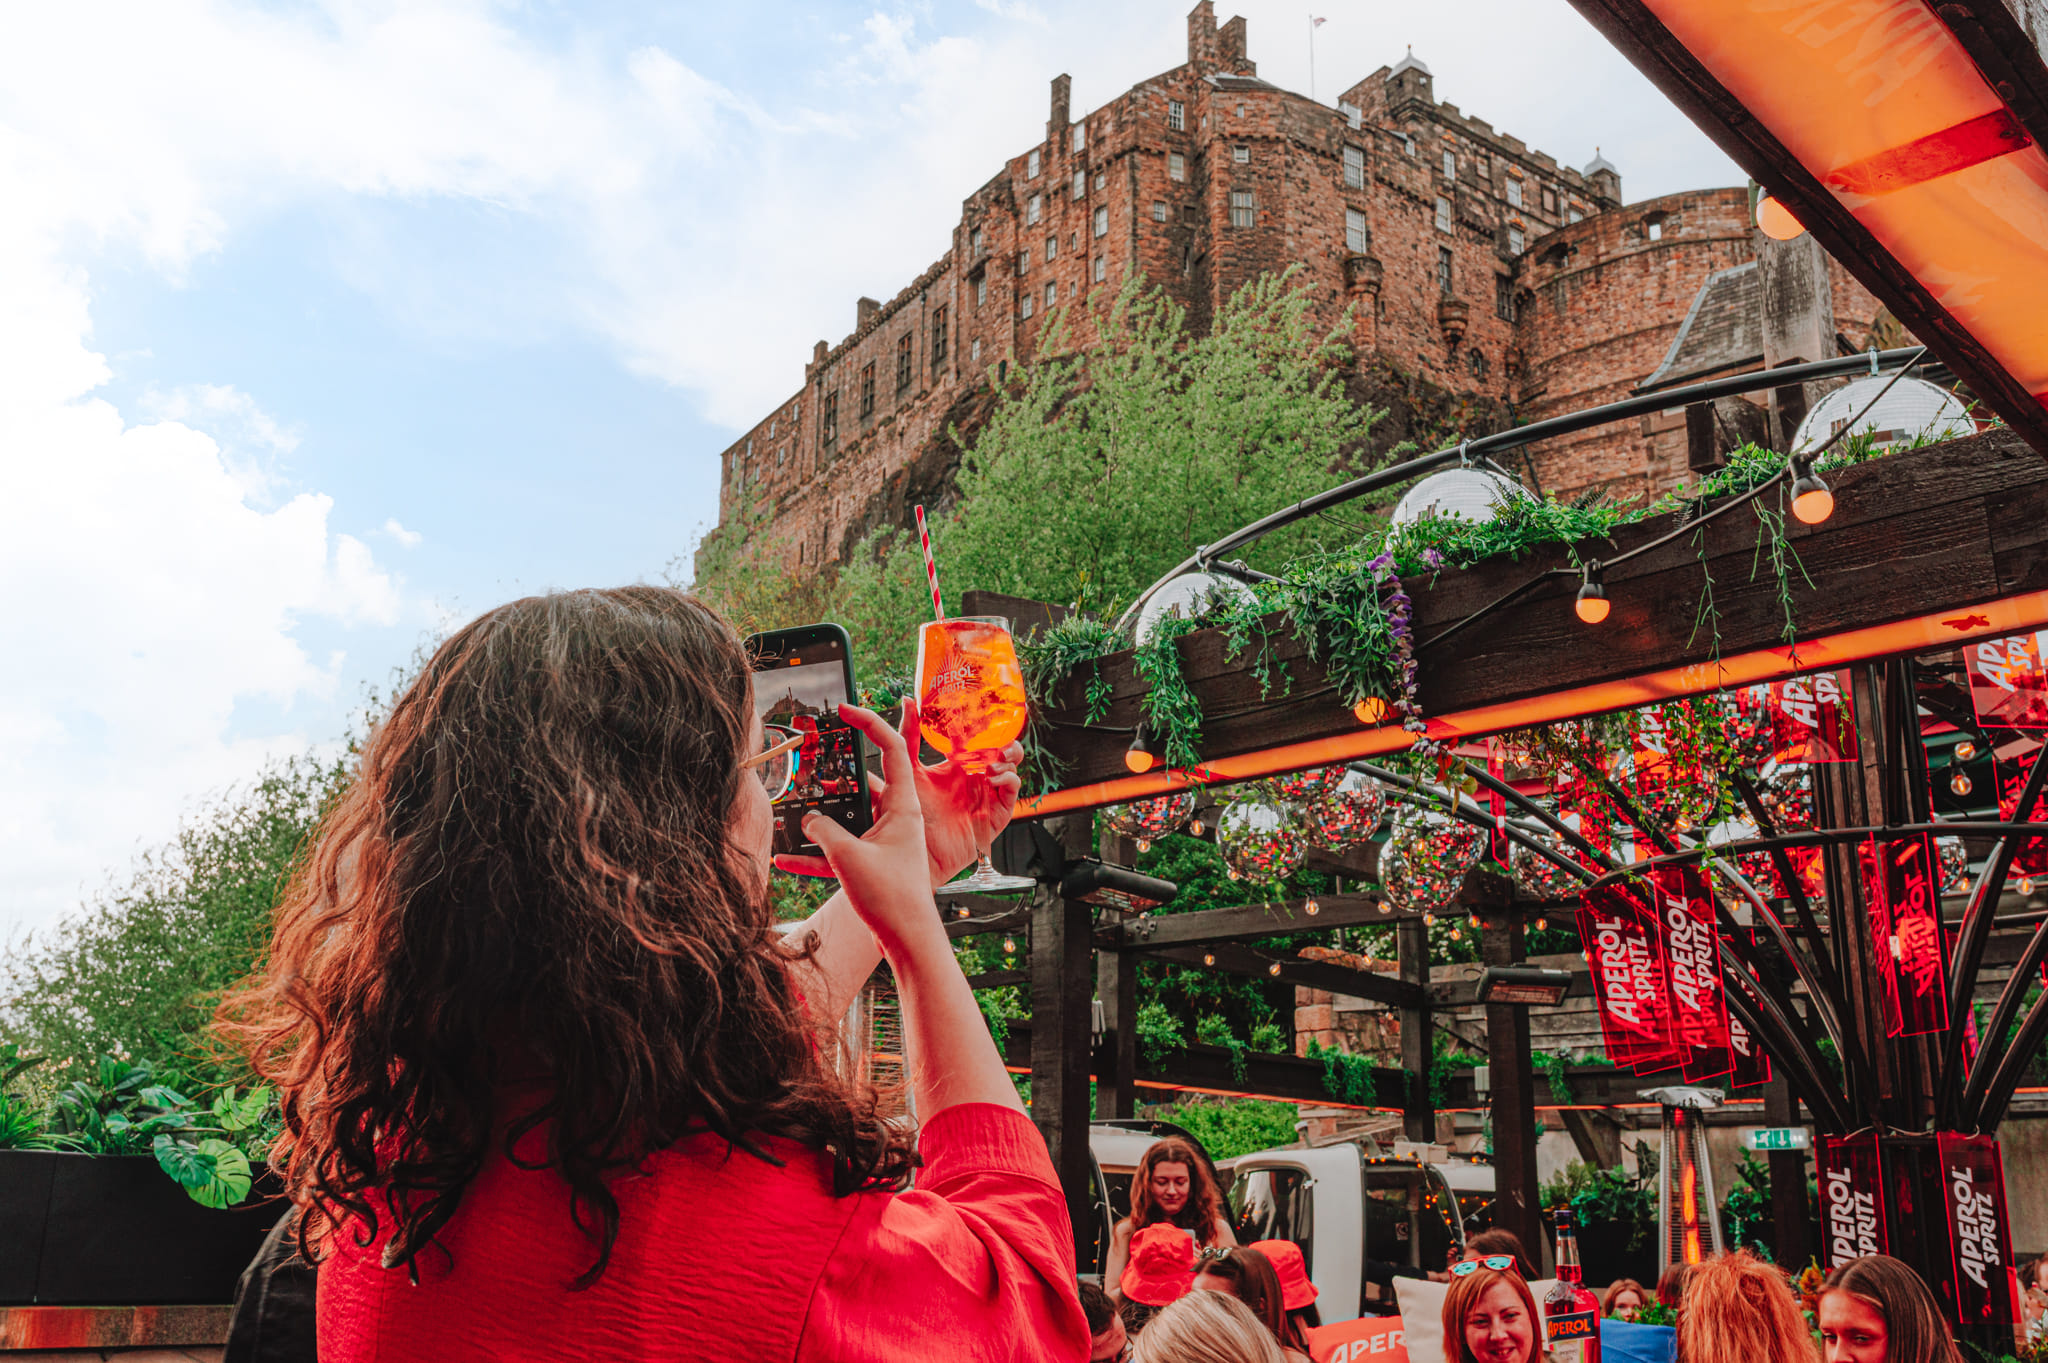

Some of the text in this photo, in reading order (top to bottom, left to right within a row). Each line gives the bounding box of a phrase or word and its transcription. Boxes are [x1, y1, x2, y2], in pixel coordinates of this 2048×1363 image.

[929, 665, 976, 691] APEROL
[1596, 916, 1640, 1024] APEROL
[1626, 936, 1656, 1000] SPRITZ
[1666, 896, 1702, 1012] APEROL
[1691, 920, 1716, 991] SPRITZ
[1951, 1166, 1988, 1288] APEROL
[1975, 1192, 2000, 1266] SPRITZ
[1547, 1318, 1592, 1339] APEROL
